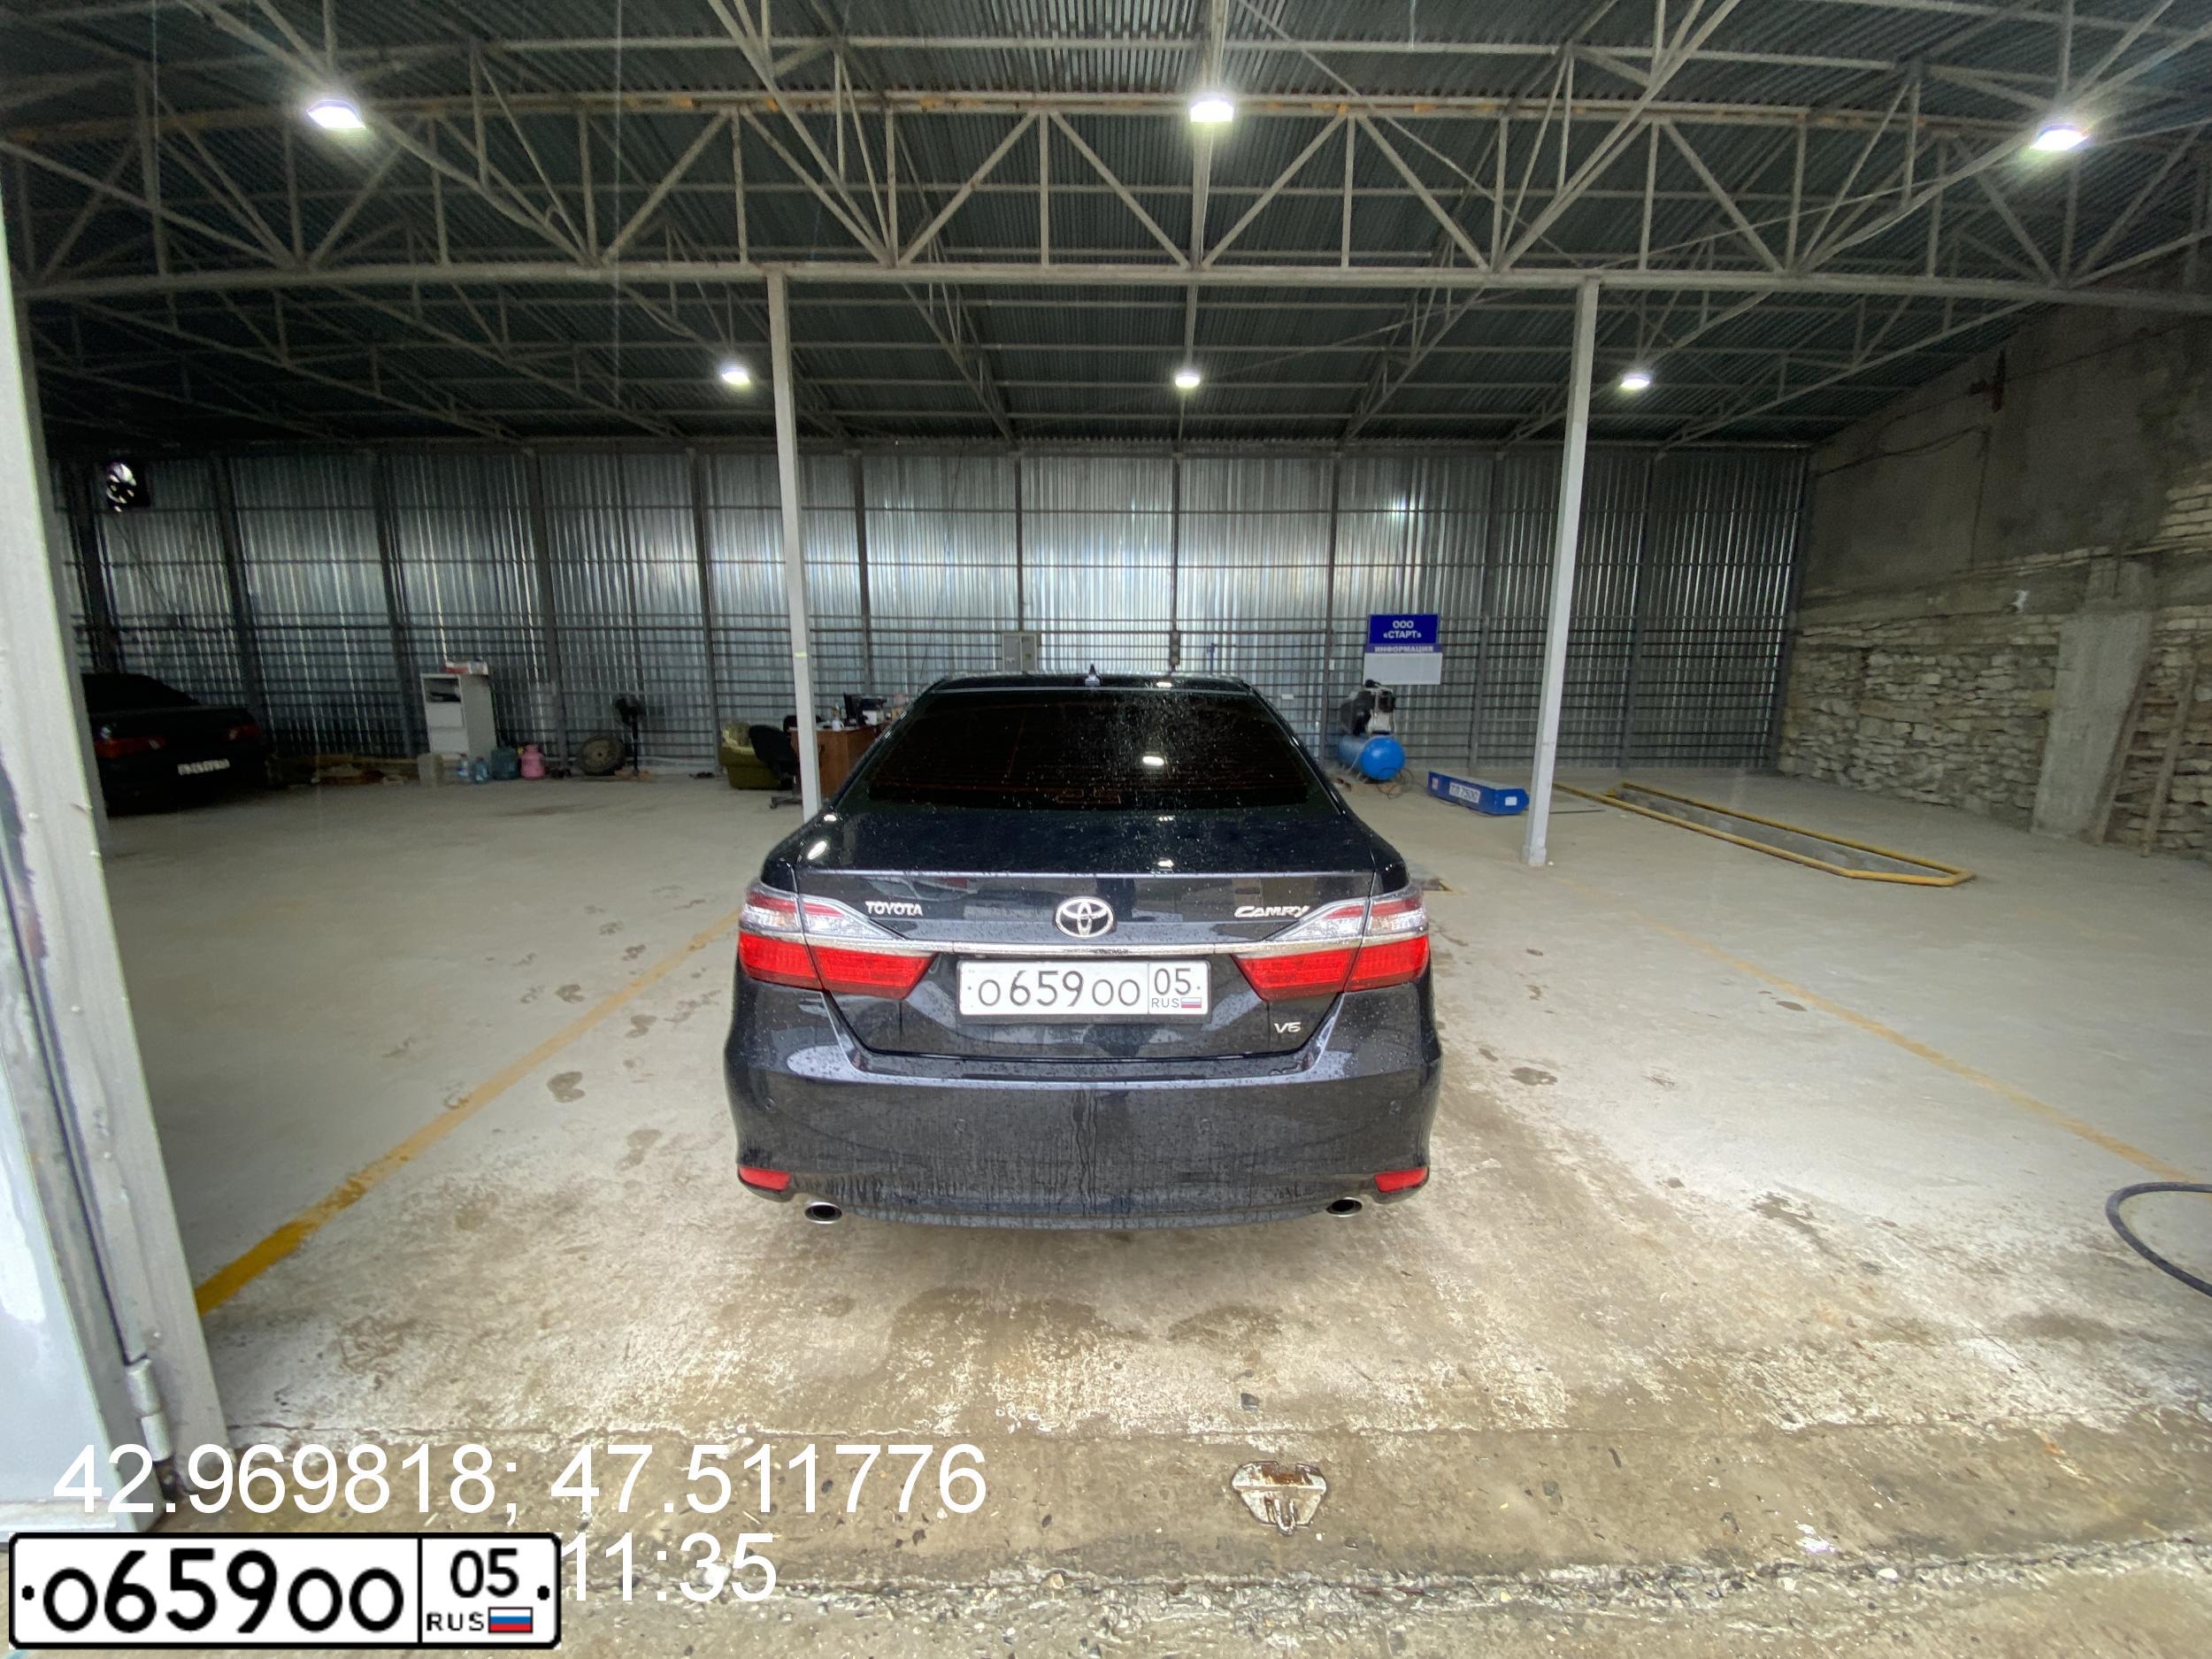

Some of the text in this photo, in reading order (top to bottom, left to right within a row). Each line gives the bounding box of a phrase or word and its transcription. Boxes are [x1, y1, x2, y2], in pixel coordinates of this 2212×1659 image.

[1392, 620, 1414, 629] ООО
[865, 901, 924, 917] TOYOTA
[1234, 905, 1310, 918] CAMRY
[1154, 968, 1192, 995] 05
[1151, 997, 1180, 1009] RUS
[1274, 1022, 1302, 1033] V6
